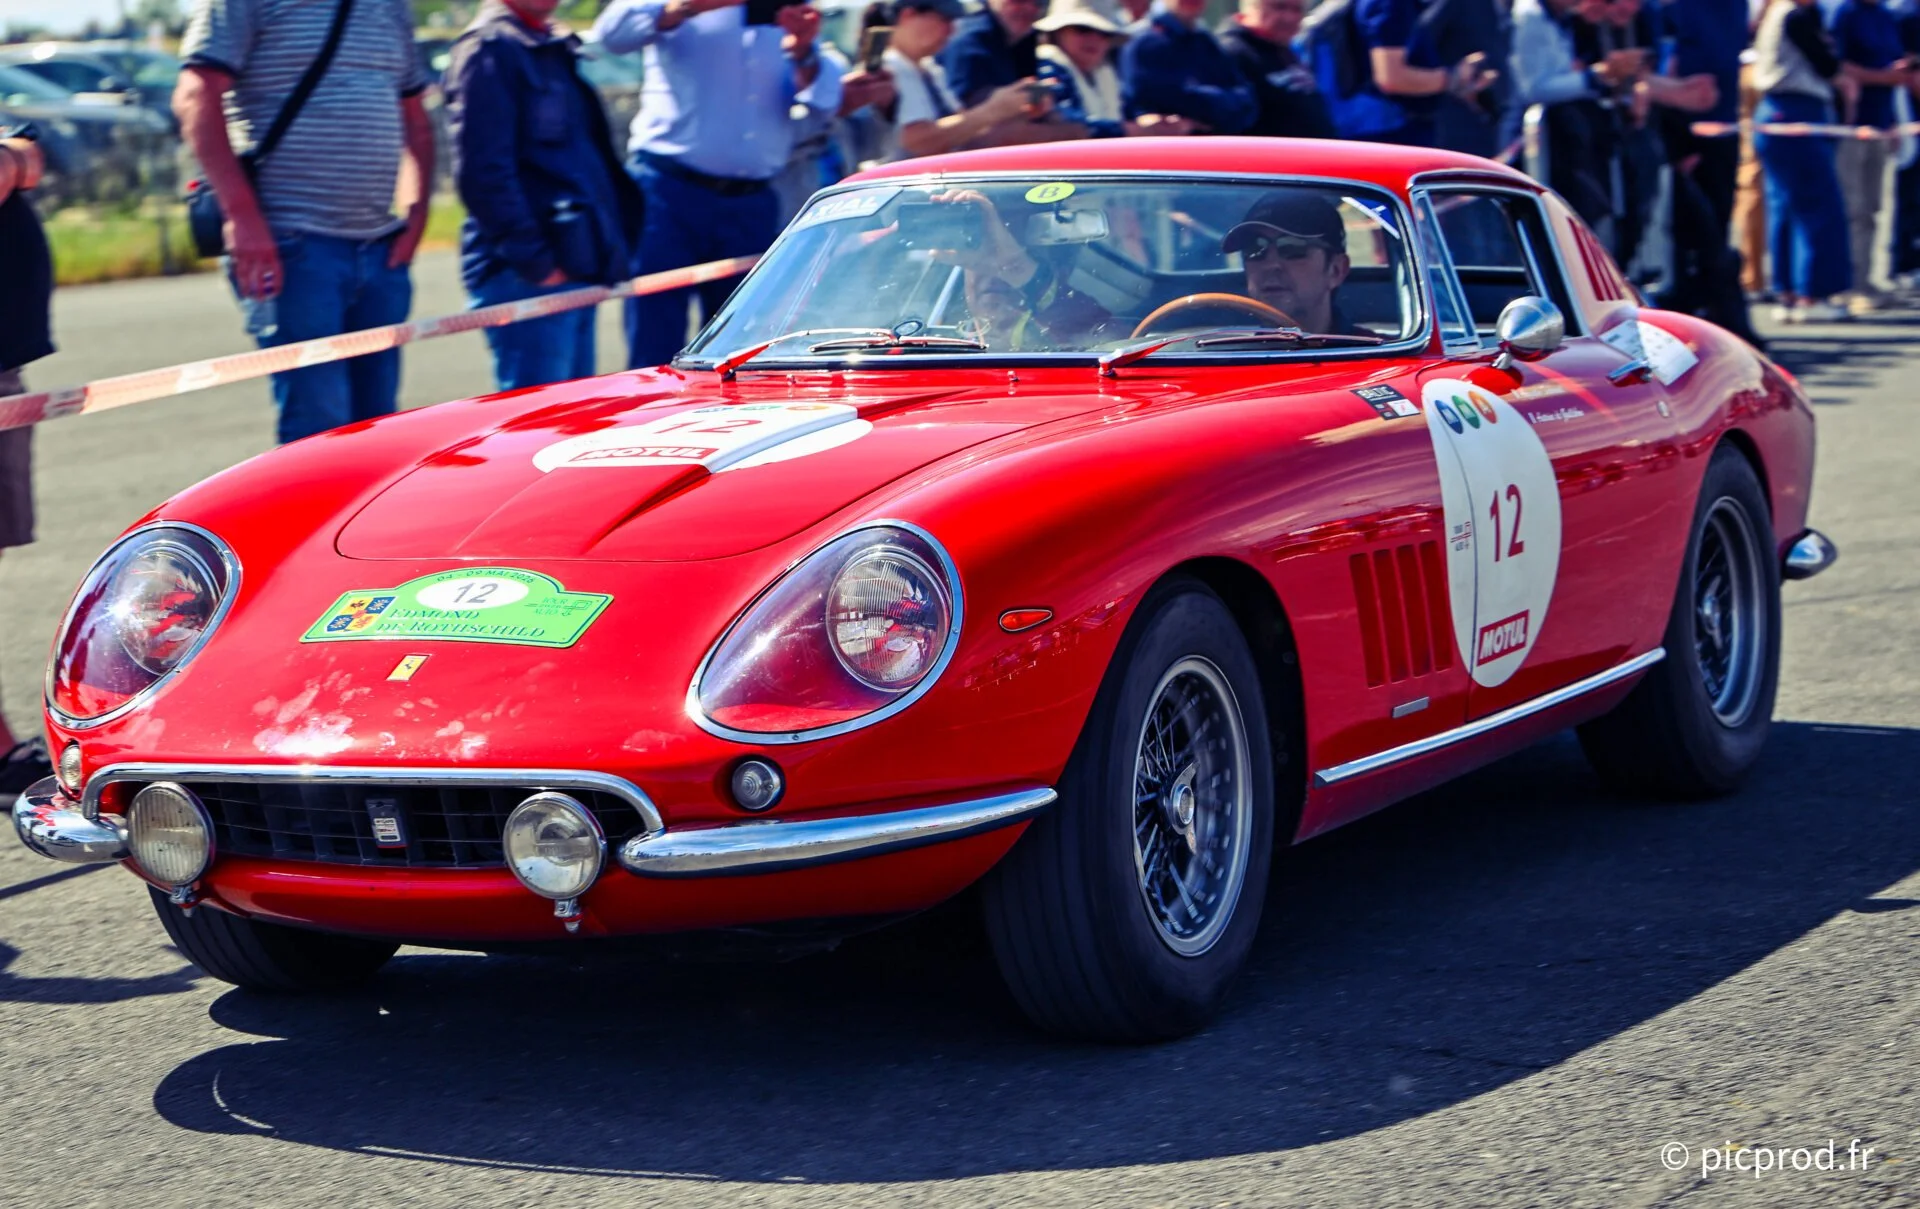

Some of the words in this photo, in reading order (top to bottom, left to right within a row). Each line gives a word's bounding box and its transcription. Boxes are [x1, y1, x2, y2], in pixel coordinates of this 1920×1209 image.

[1037, 186, 1061, 199] B
[652, 419, 763, 435] 12
[575, 447, 705, 461] MOTUL
[1489, 484, 1525, 563] 12
[453, 582, 499, 604] 12
[389, 608, 480, 620] EDMOND
[409, 621, 545, 638] ROTHSCHILD
[1480, 616, 1527, 660] MOTUL
